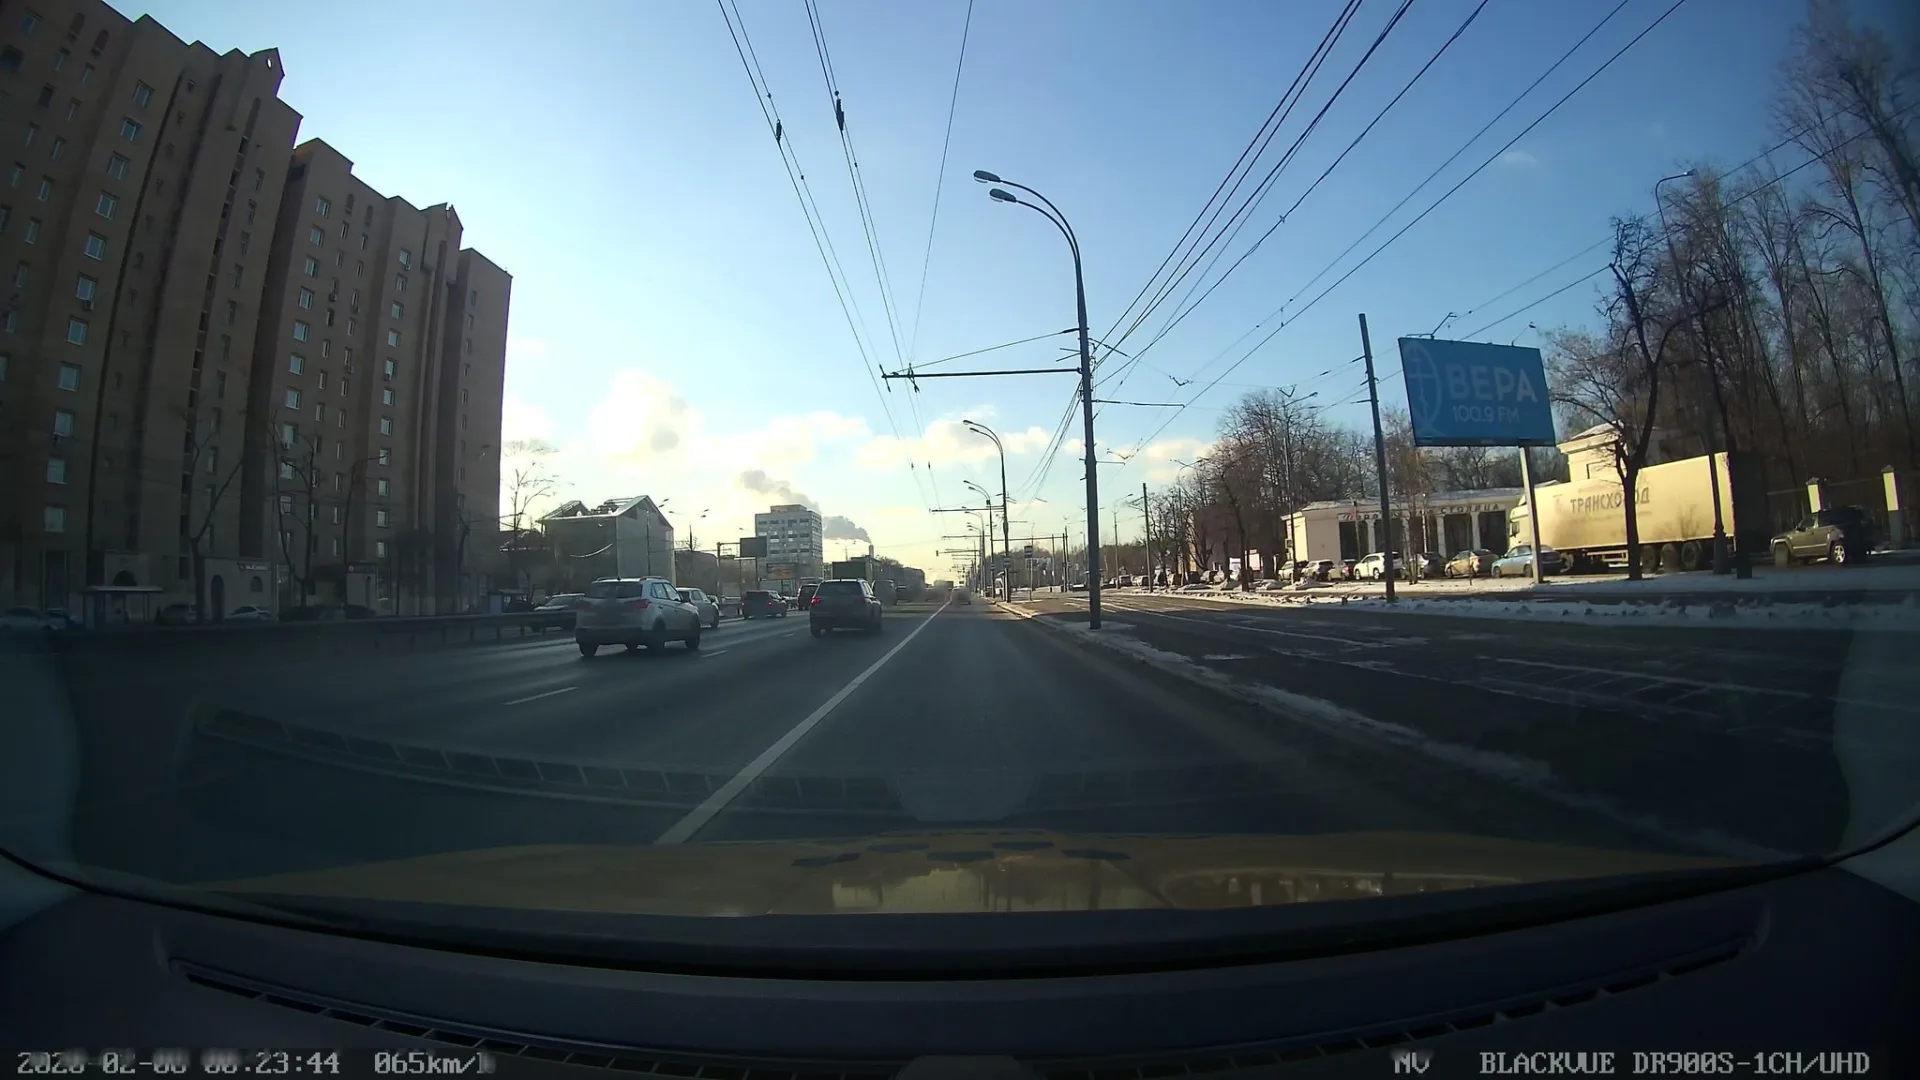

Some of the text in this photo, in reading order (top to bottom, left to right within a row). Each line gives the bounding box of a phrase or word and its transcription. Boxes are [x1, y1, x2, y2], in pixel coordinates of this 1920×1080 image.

[1446, 364, 1538, 403] ВЕРА
[1498, 406, 1519, 422] FM
[1570, 487, 1650, 513] ТРАНСХООД
